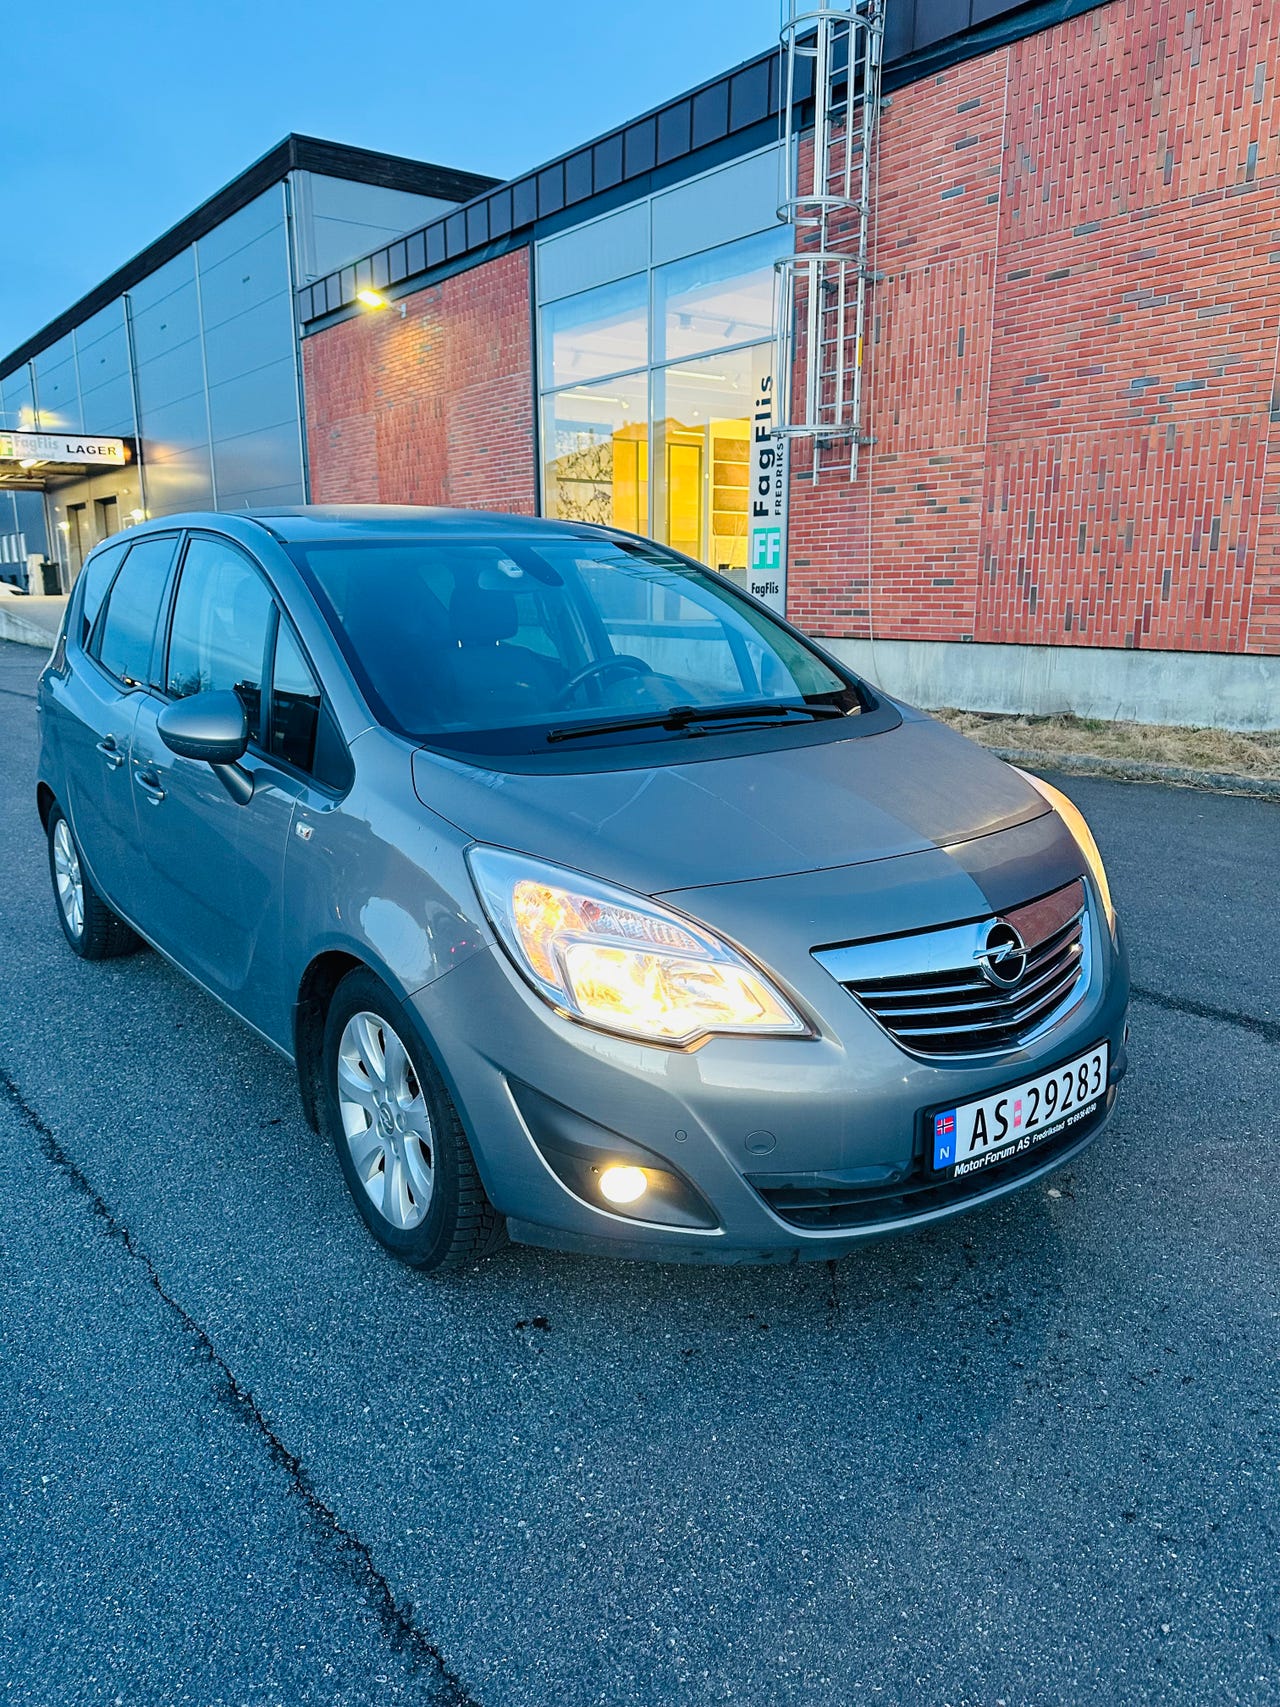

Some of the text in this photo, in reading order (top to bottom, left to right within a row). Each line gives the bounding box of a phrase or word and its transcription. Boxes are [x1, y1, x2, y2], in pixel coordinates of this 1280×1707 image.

[66, 444, 117, 456] LAGER
[753, 376, 775, 517] FagFlis
[751, 581, 779, 597] FagFlis
[969, 1055, 1102, 1151] AS 29283
[1016, 1136, 1031, 1152] AS
[939, 1146, 950, 1160] N
